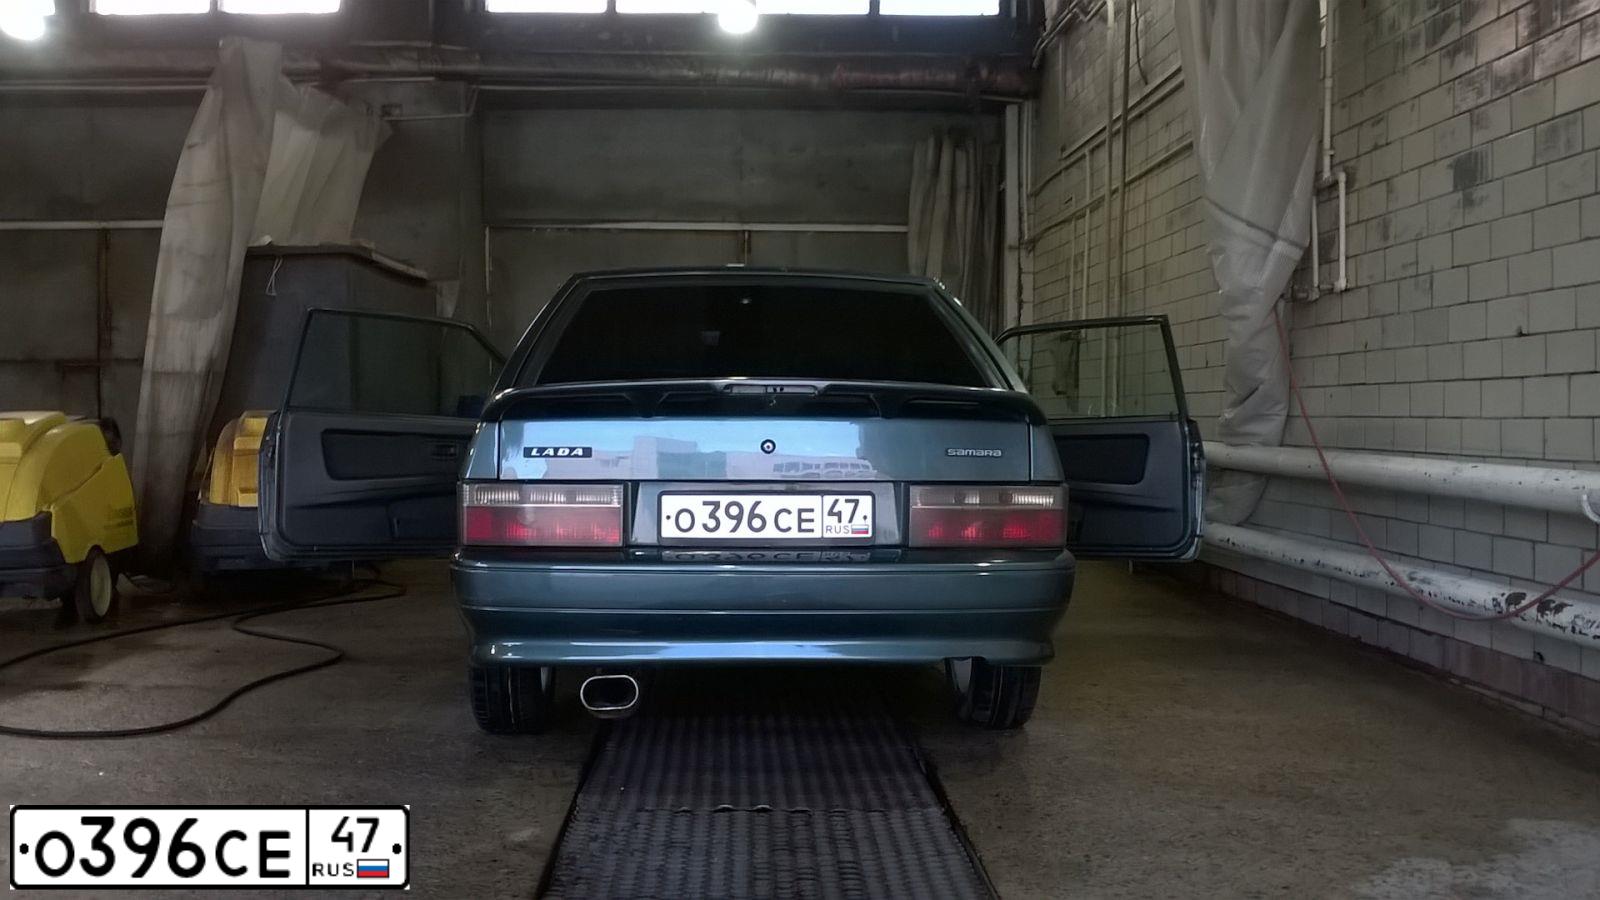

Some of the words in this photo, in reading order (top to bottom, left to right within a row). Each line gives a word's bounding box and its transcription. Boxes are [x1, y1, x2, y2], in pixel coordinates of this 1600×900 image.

[529, 447, 585, 457] LADA
[827, 498, 860, 524] 47
[825, 524, 850, 534] RUS
